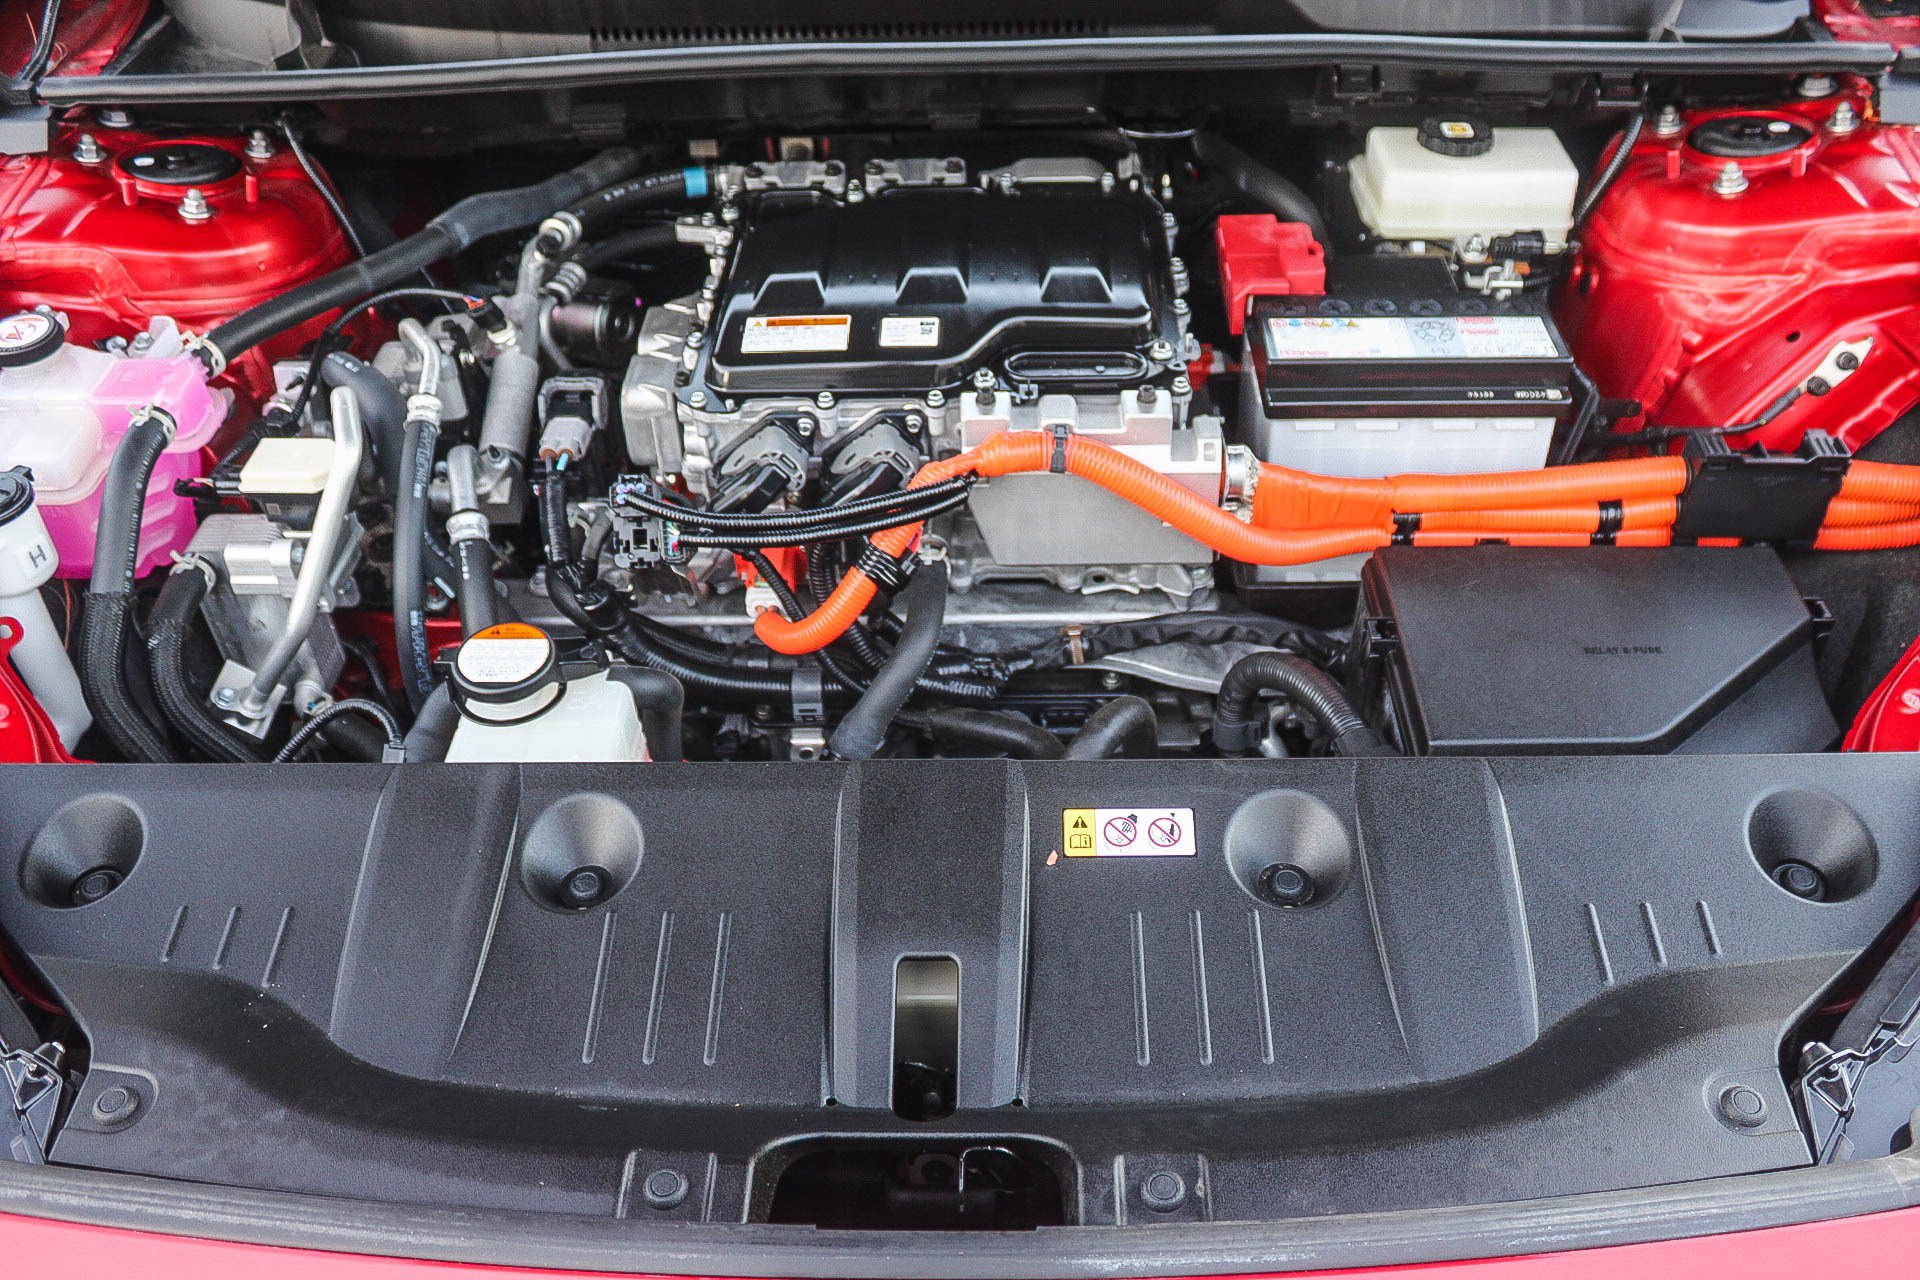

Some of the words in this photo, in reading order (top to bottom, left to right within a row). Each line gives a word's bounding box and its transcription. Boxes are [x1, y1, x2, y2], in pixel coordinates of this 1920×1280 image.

[29, 545, 46, 568] H
[1583, 646, 1619, 655] RELAY
[1622, 646, 1631, 655] &
[1633, 646, 1663, 655] FUSE
